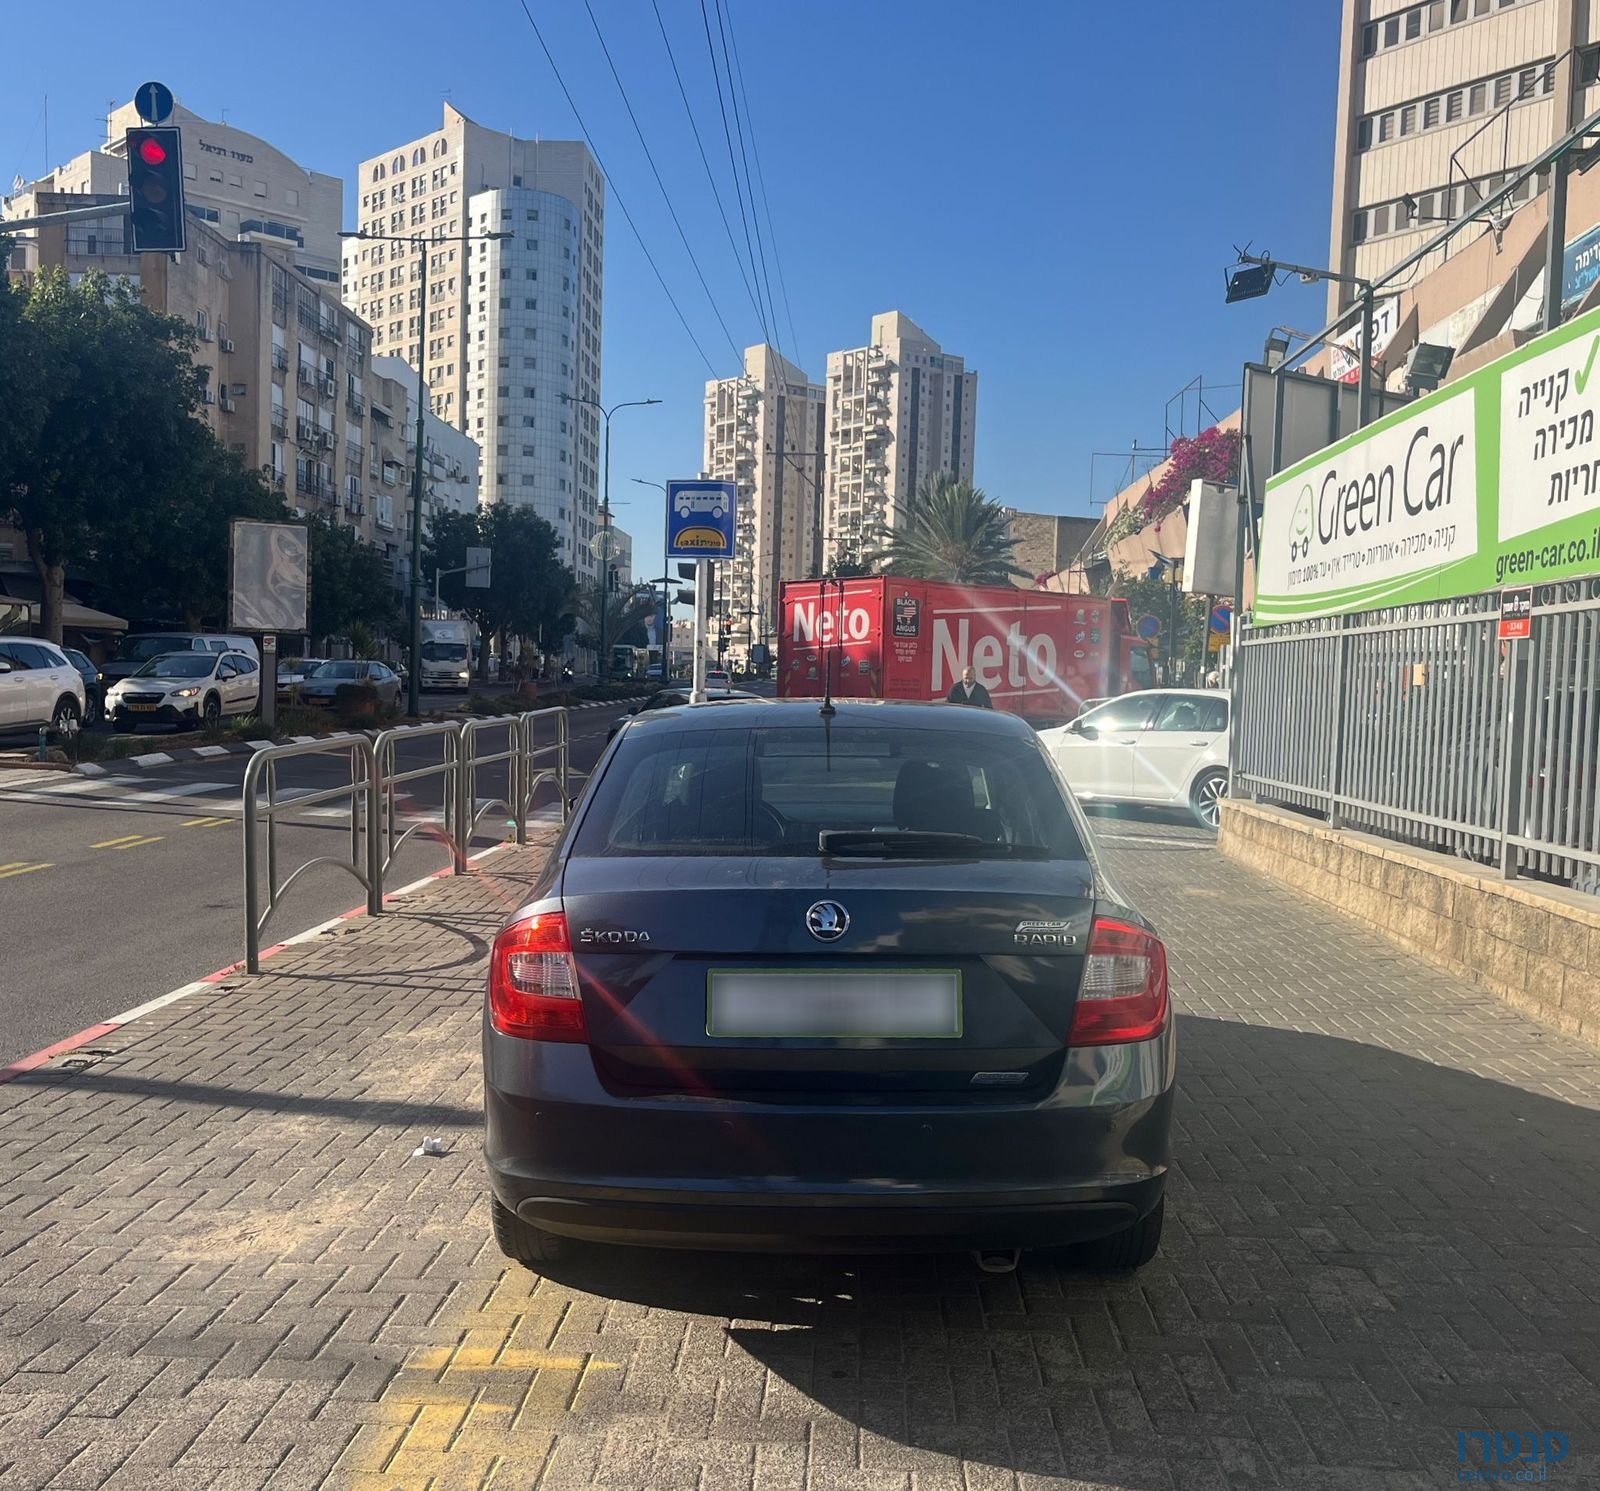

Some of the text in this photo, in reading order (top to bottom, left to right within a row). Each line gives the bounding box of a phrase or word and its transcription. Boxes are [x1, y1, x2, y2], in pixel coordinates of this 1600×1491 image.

[1575, 240, 1600, 271] דימה
[1518, 367, 1570, 418] קנייה
[1533, 408, 1594, 461] מכירה
[1318, 426, 1464, 545] Green Car
[1547, 459, 1600, 506] חריות
[680, 535, 699, 546] taxi
[1400, 532, 1426, 557] מכירה
[1433, 525, 1456, 552] קניה
[1366, 541, 1395, 566] אחריות
[896, 598, 916, 606] BLACK
[793, 601, 870, 643] Neto
[896, 624, 916, 632] ANGUS
[931, 617, 1058, 692] Neto
[580, 928, 651, 943] ŠKODA
[1013, 934, 1077, 947] RAPID
